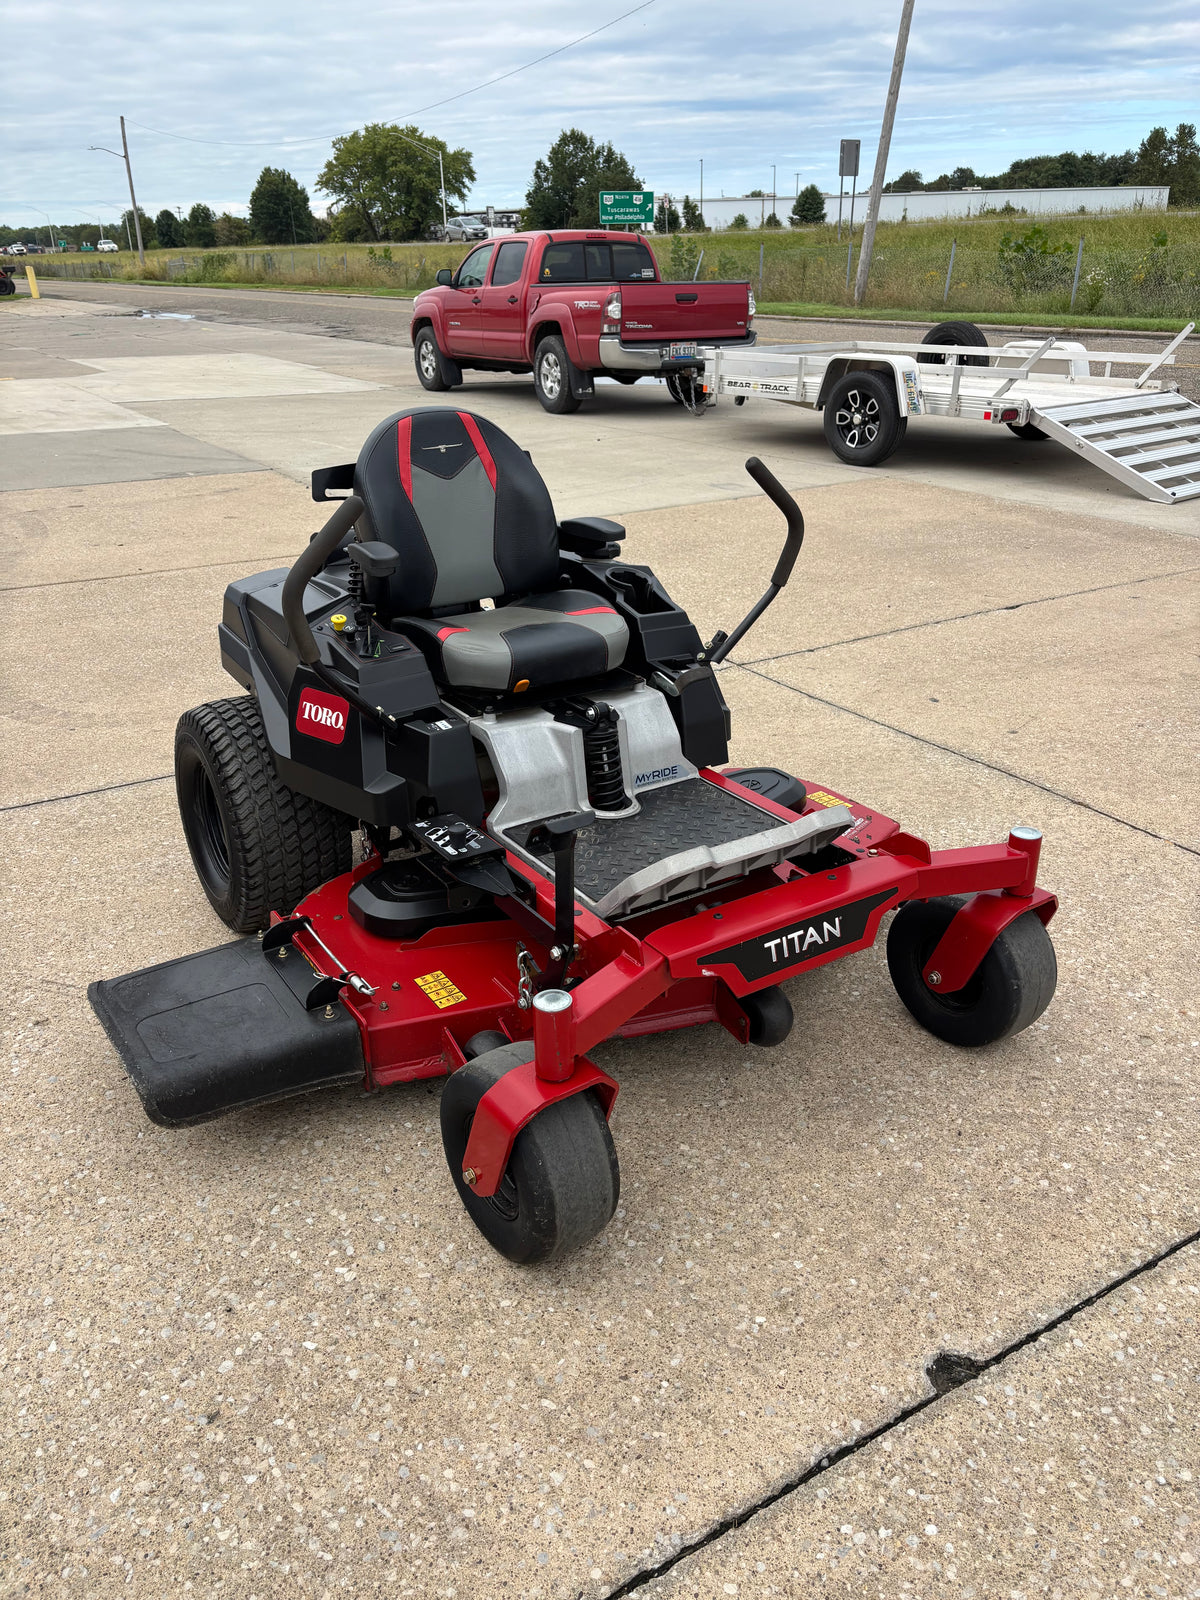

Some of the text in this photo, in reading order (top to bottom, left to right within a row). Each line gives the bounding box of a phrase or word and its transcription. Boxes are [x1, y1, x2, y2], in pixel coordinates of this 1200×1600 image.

[574, 301, 589, 309] TRD
[760, 383, 790, 392] TRACK
[302, 701, 344, 729] TORO
[763, 917, 841, 963] TITAN
